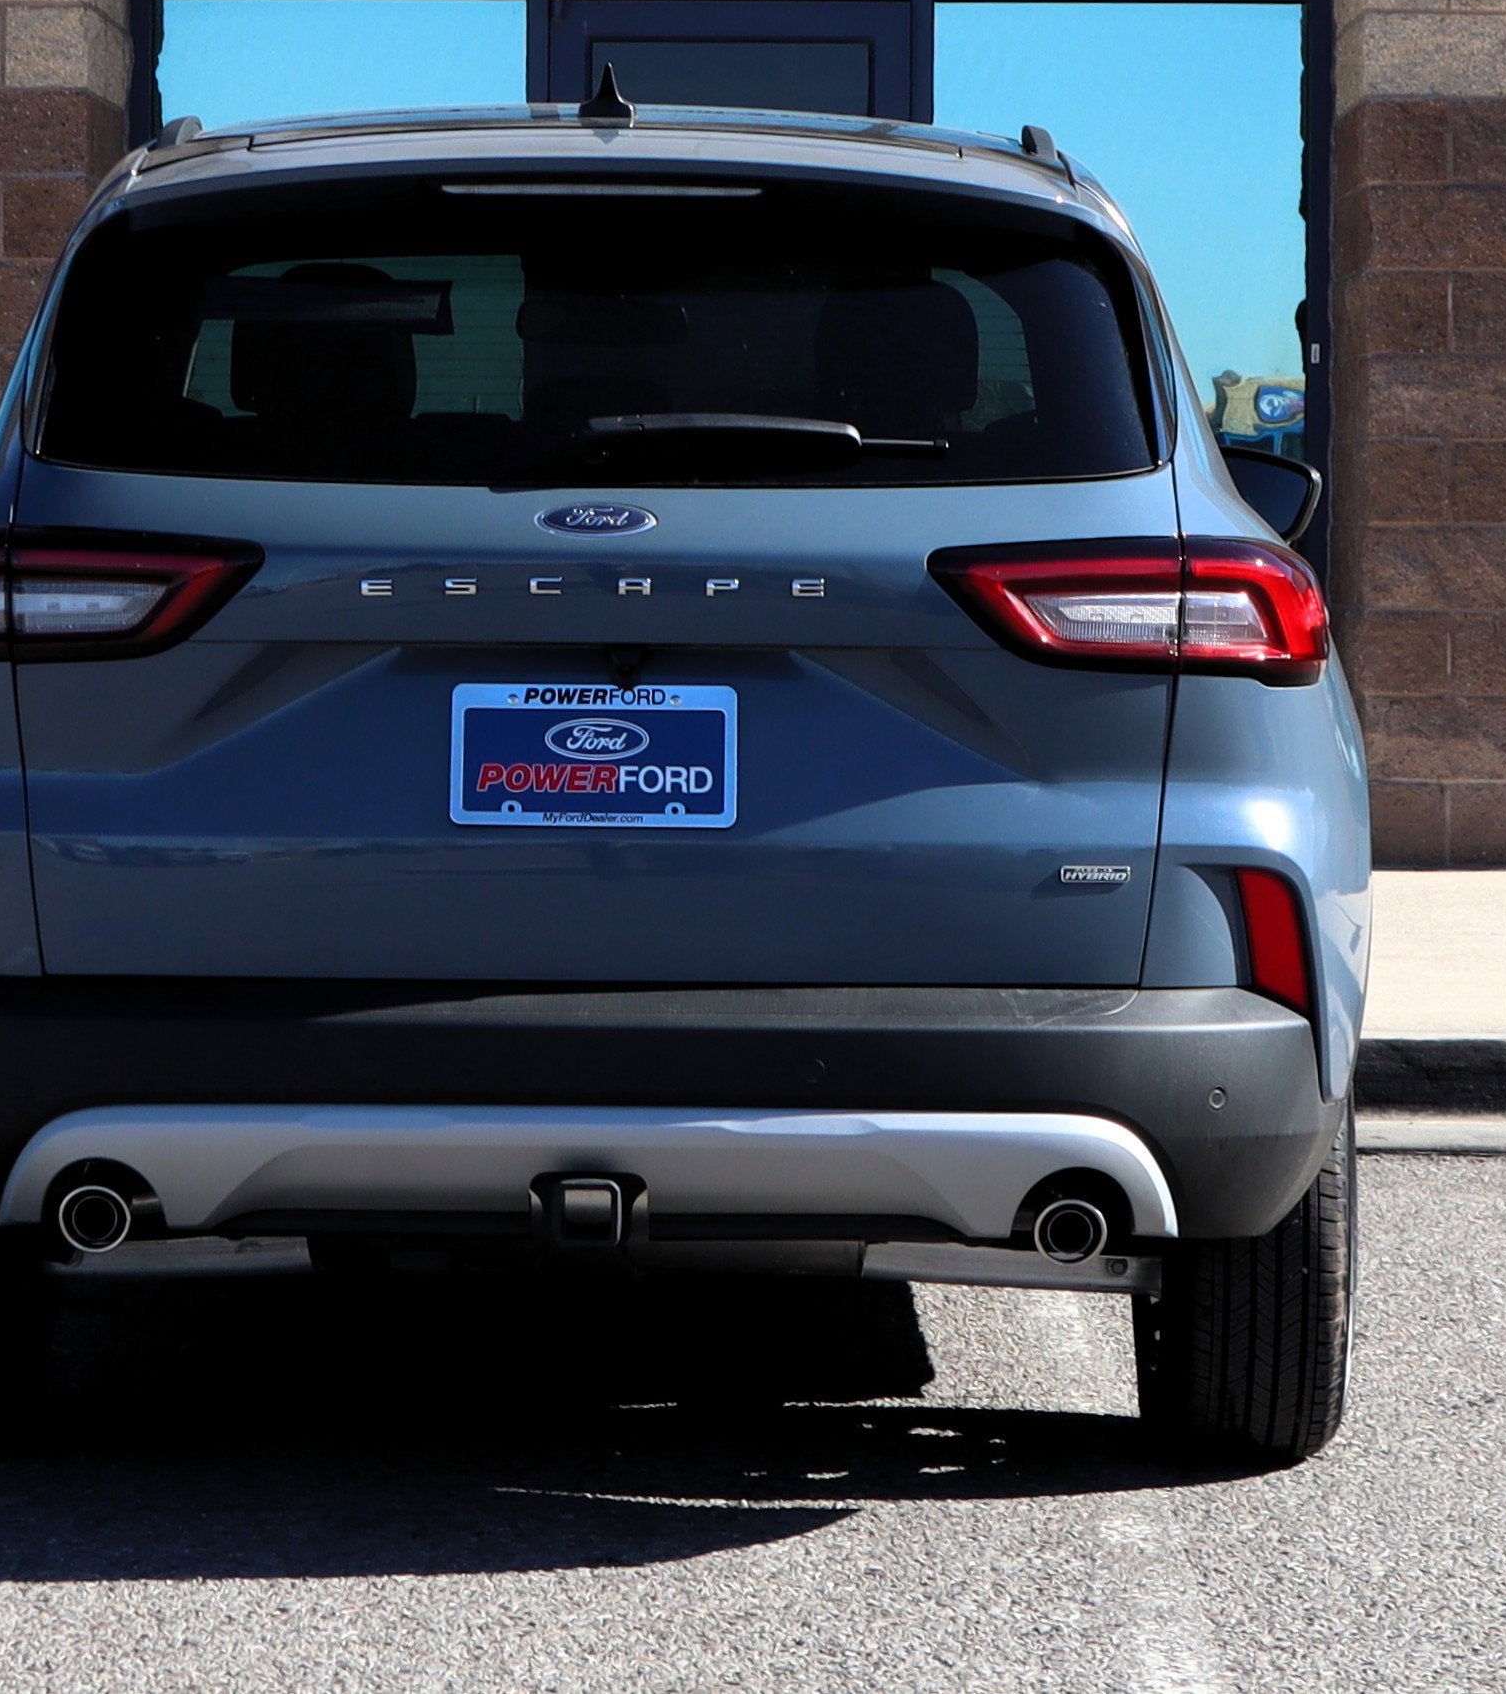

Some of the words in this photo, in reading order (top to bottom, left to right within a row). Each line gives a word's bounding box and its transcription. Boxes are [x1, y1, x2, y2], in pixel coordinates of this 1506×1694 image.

[566, 507, 631, 527] Ford
[360, 576, 826, 598] ESCAPE
[523, 687, 667, 706] POWERFORD
[565, 725, 627, 751] Ford
[476, 762, 714, 795] POWERFORD
[1064, 871, 1128, 881] HYBRID
